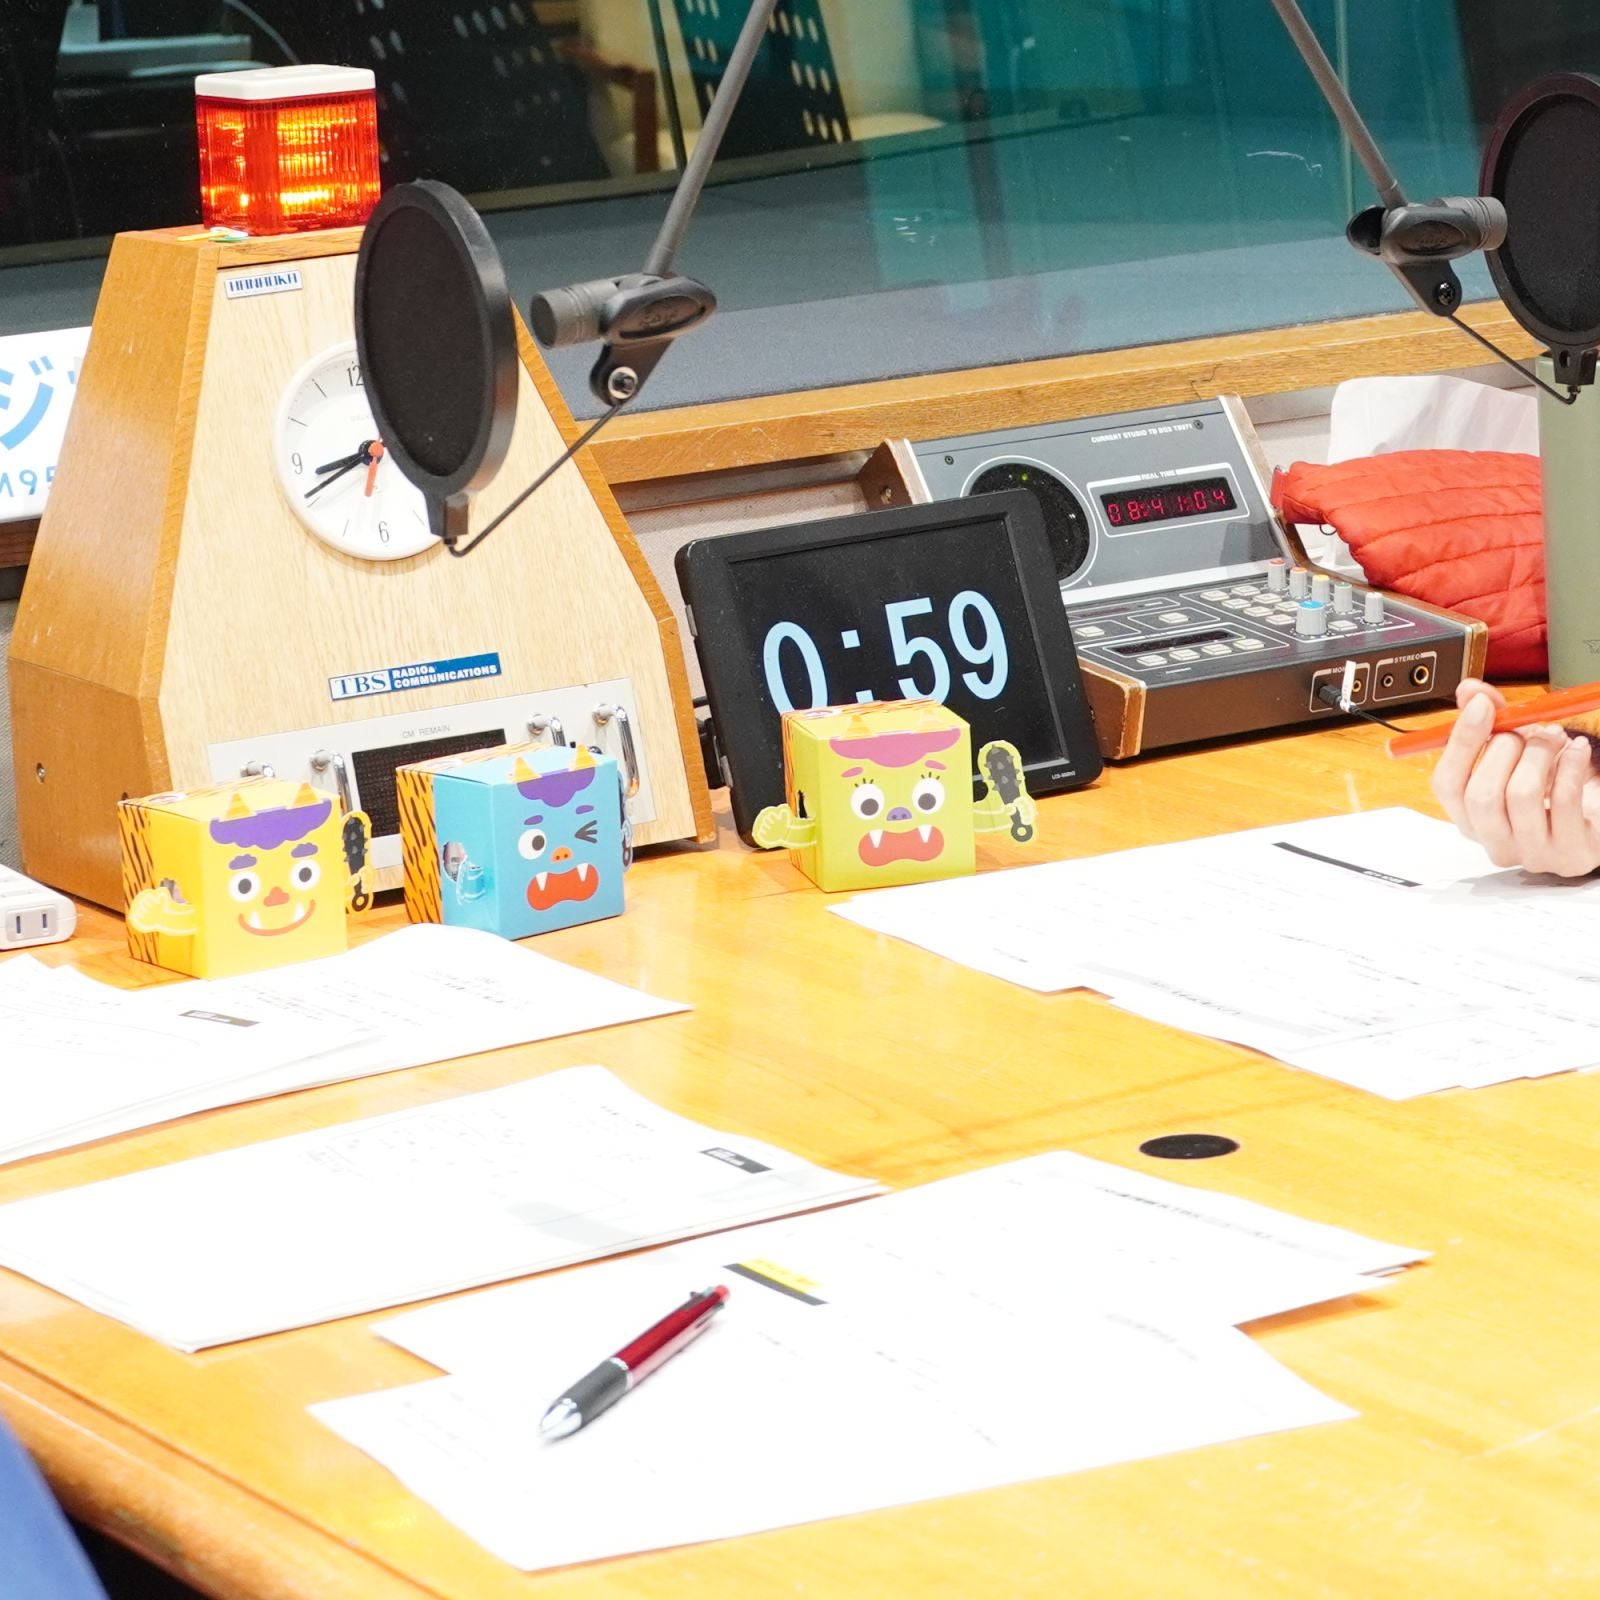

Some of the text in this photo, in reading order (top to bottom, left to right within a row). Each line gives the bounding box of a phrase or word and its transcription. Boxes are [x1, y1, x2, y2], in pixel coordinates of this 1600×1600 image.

[291, 452, 303, 475] 9
[378, 520, 390, 544] 6
[763, 589, 1008, 714] 0:59
[1394, 652, 1421, 664] STEREO
[335, 664, 498, 696] TBS COMMUNICATIONS
[402, 724, 451, 740] CM REMAIN
